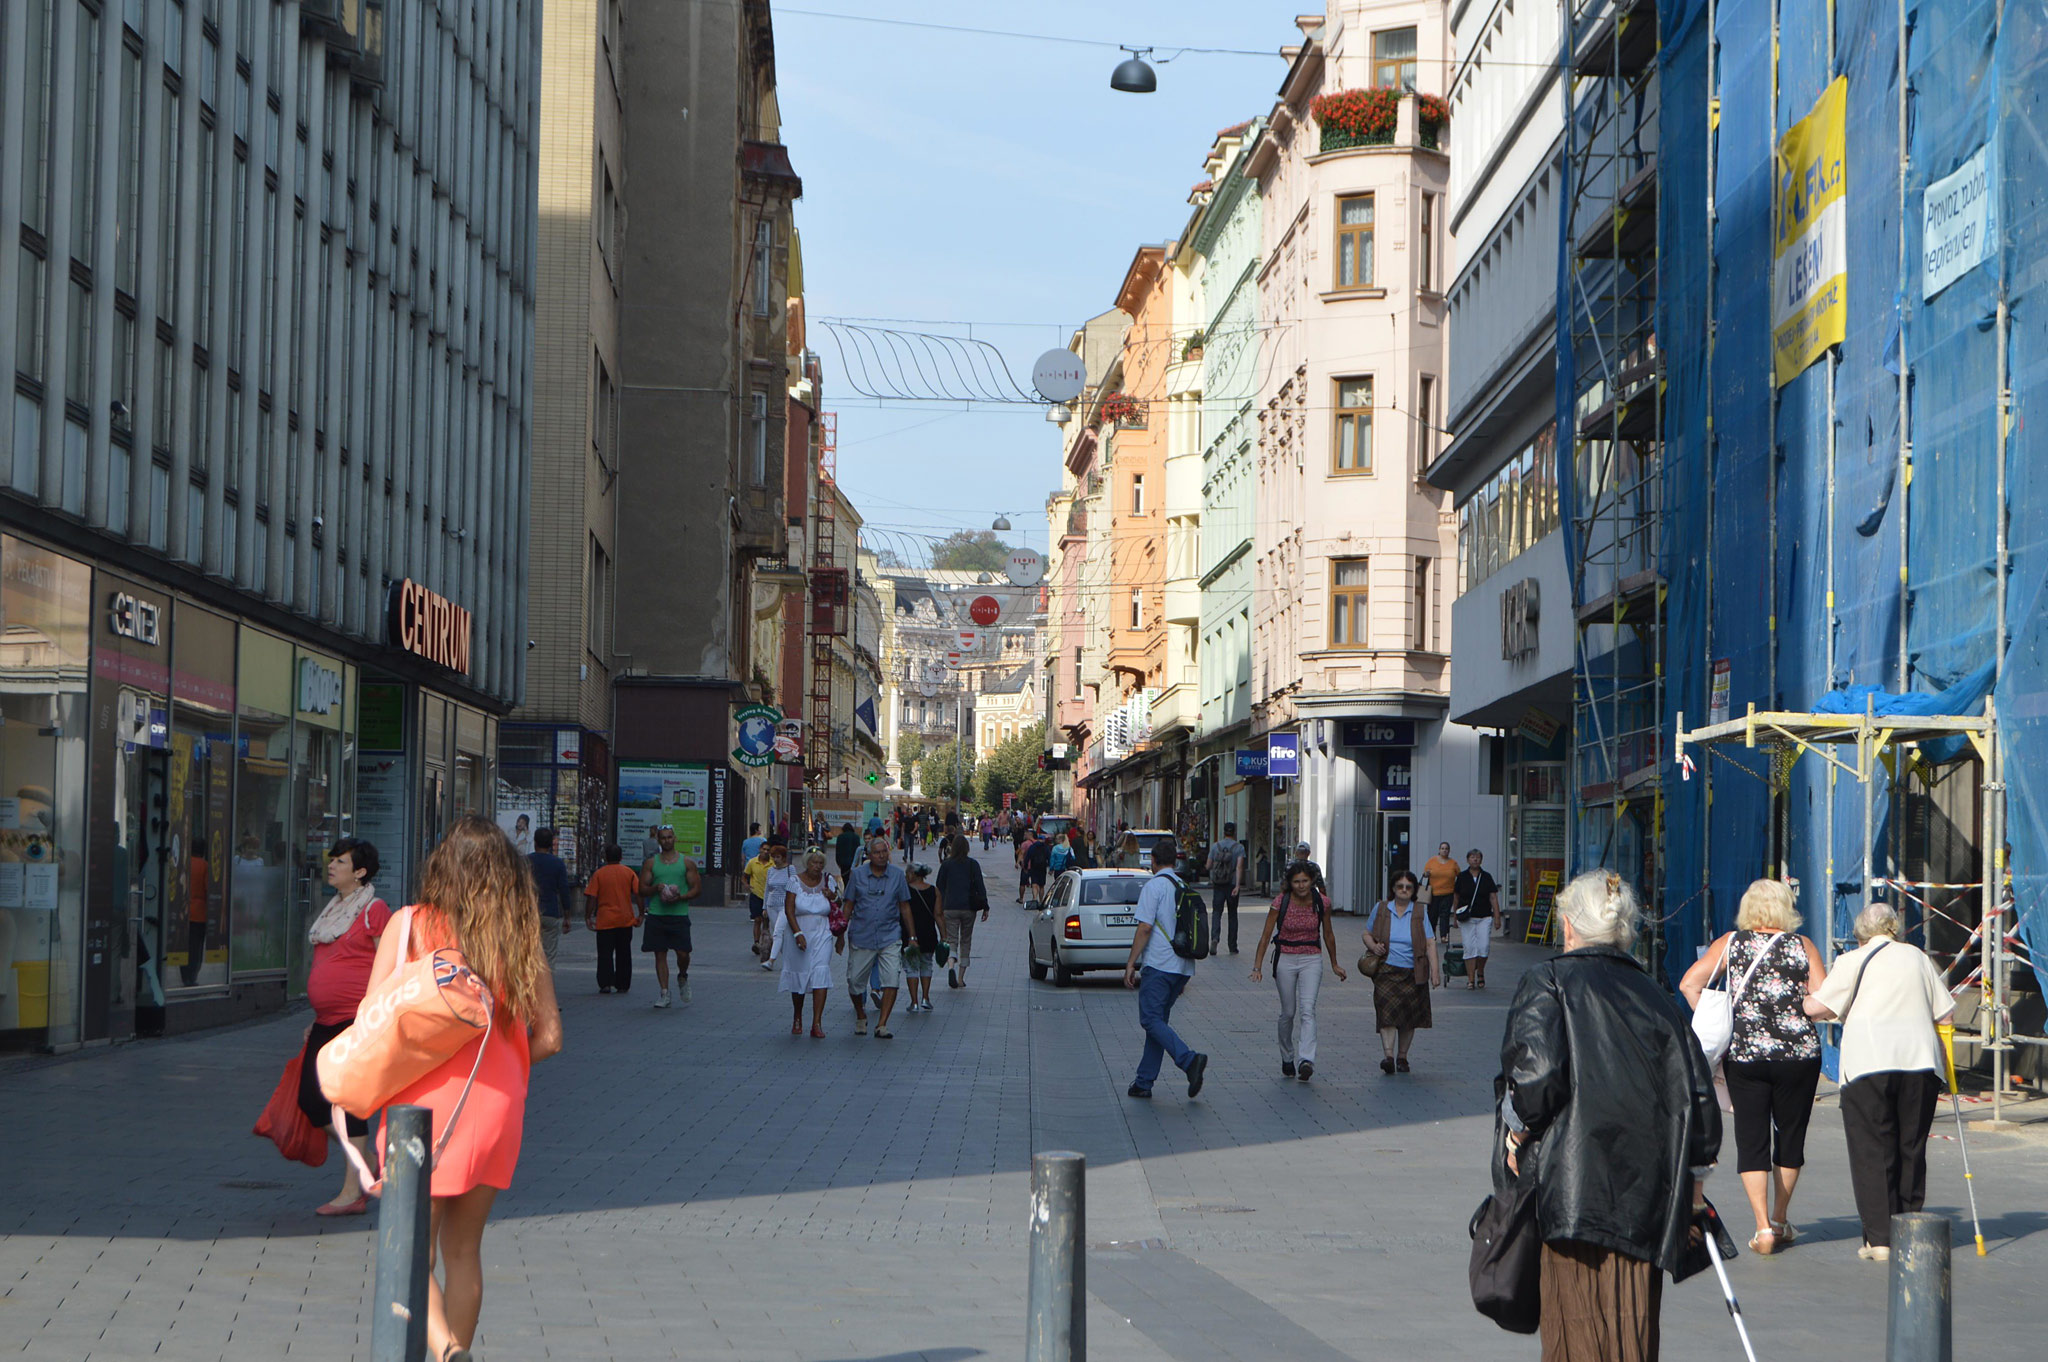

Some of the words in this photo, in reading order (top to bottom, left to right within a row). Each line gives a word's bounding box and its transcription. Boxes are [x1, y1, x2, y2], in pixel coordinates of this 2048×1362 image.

[1925, 190, 1960, 234] Provoz
[1789, 220, 1823, 307] LEŠENÍ
[111, 592, 161, 646] CENTEX
[400, 577, 471, 676] CENTRUM
[1120, 708, 1128, 747] STIVAL
[1364, 723, 1395, 741] firo
[740, 753, 768, 766] MAPY
[1237, 756, 1268, 766] FOKUS
[1270, 746, 1296, 759] firo
[1386, 764, 1411, 786] fir
[715, 782, 724, 823] EXCHANGE
[713, 826, 723, 869] SMĚNÁRNA
[328, 975, 421, 1064] aidas
